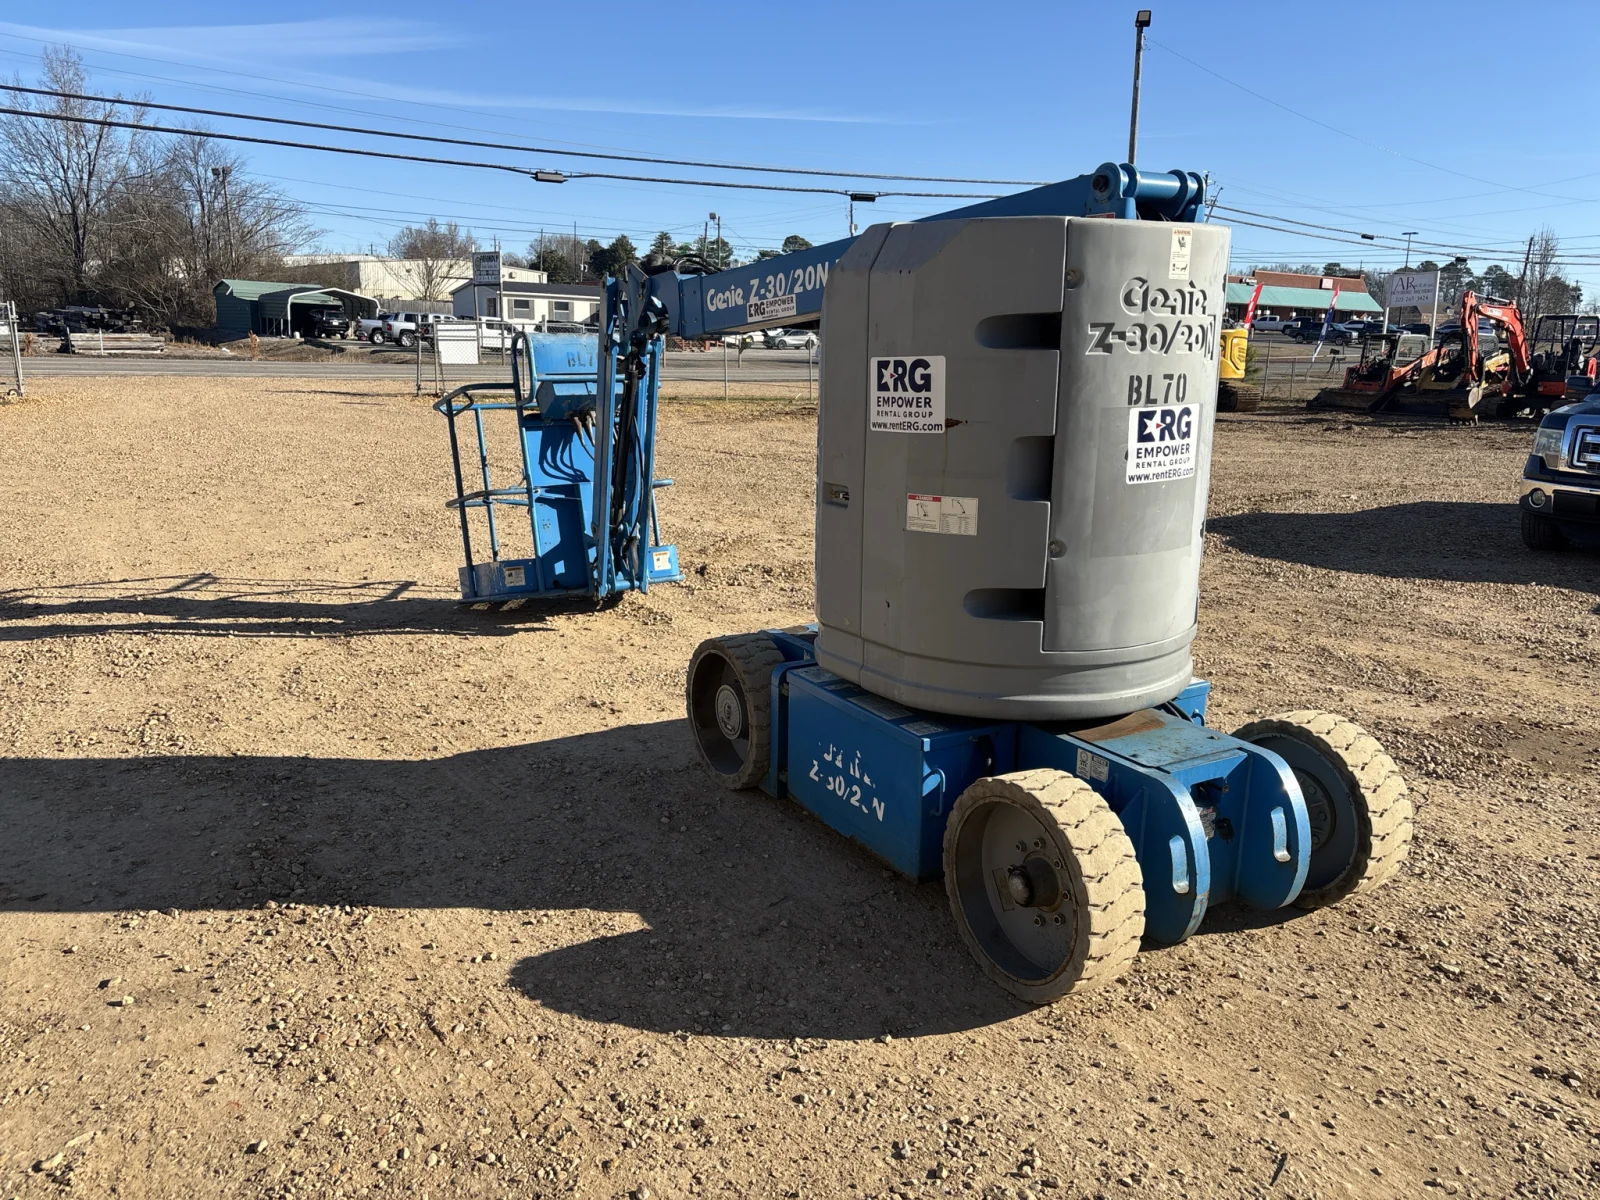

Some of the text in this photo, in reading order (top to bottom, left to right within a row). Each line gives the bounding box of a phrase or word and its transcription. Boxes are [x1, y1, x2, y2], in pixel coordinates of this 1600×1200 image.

[707, 261, 829, 312] Genie Z-30/20N
[766, 296, 794, 308] EMPOWER
[1120, 276, 1208, 317] Genie
[748, 302, 766, 318] ERG
[877, 358, 932, 393] ERG
[876, 396, 932, 408] EMPOWER
[872, 421, 943, 431] www.rentERG.com
[1137, 407, 1192, 443] ERG
[1136, 443, 1190, 459] EMPOWER
[1136, 457, 1190, 469] RENTAL GROUP
[1128, 468, 1194, 482] www.rentERG.com
